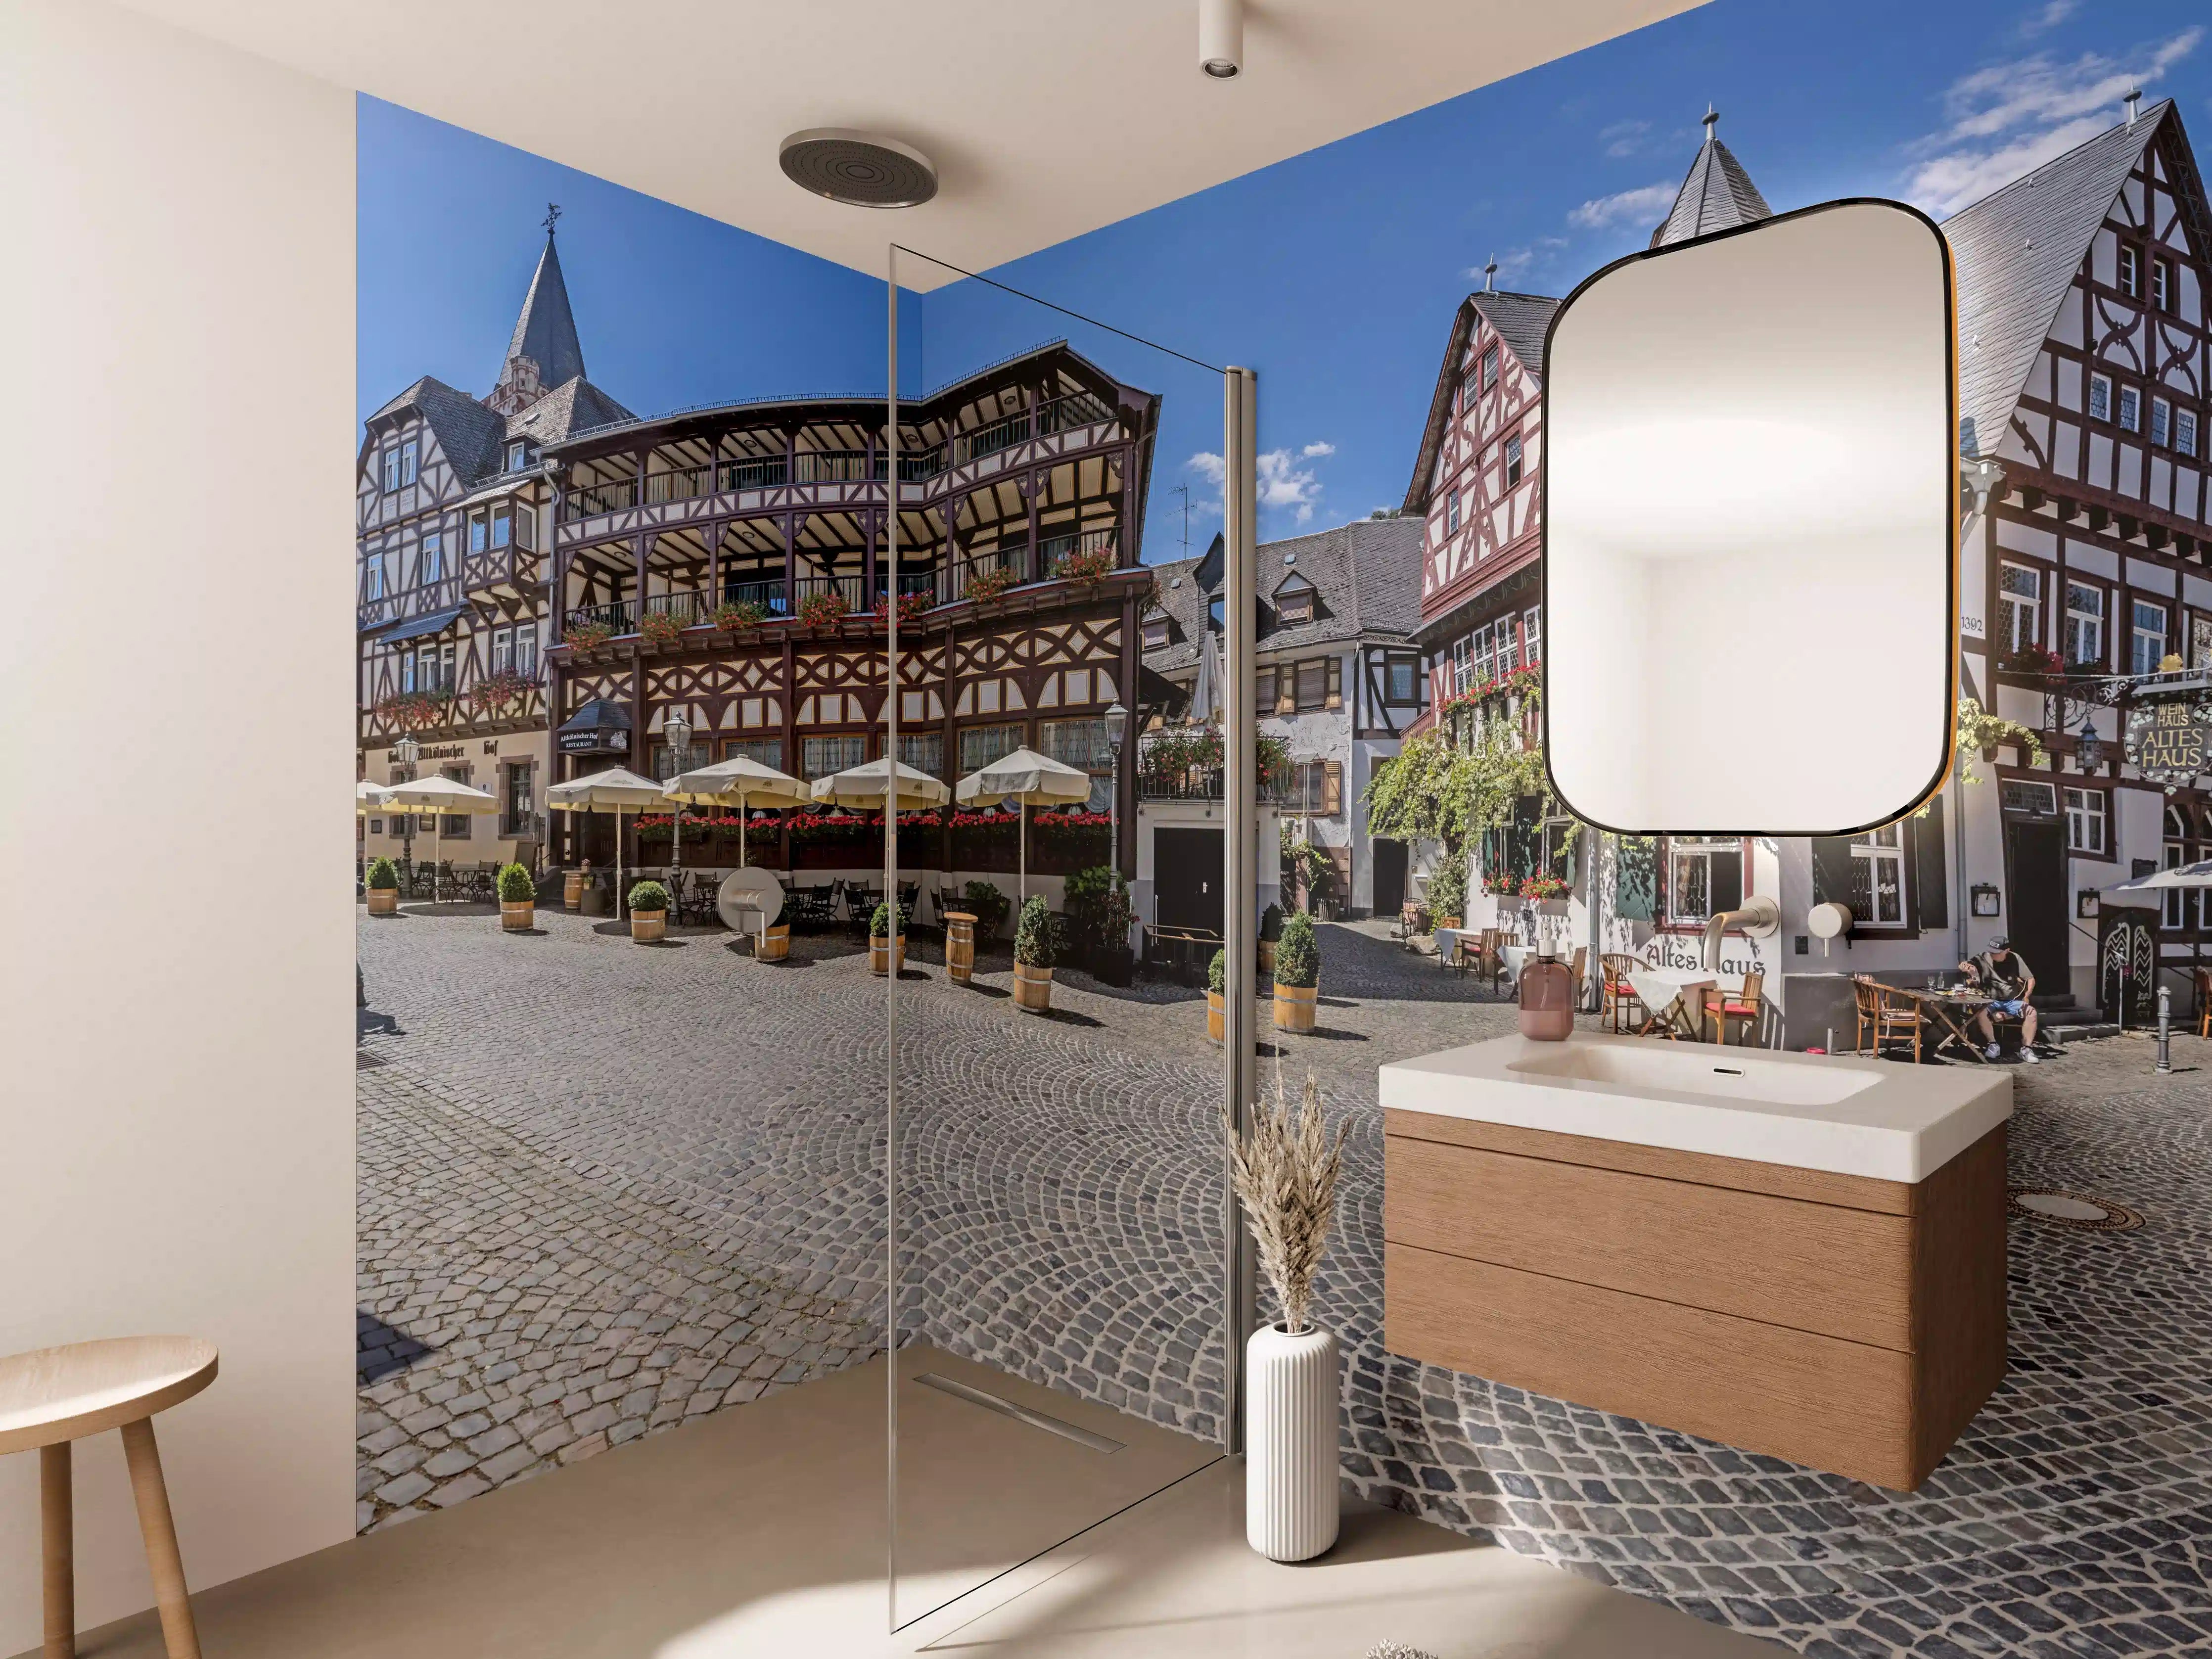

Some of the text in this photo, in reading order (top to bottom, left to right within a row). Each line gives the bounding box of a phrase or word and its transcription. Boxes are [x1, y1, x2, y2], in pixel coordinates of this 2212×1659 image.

[1961, 617, 1982, 632] 1392
[2159, 702, 2186, 715] WEIN
[2157, 714, 2189, 728] HAUS
[560, 733, 589, 742] Altkölnischer
[2142, 728, 2203, 748] ALTES
[484, 740, 498, 757] Hof
[2142, 748, 2201, 767] HAUS
[1646, 941, 1766, 976] Altes aus
